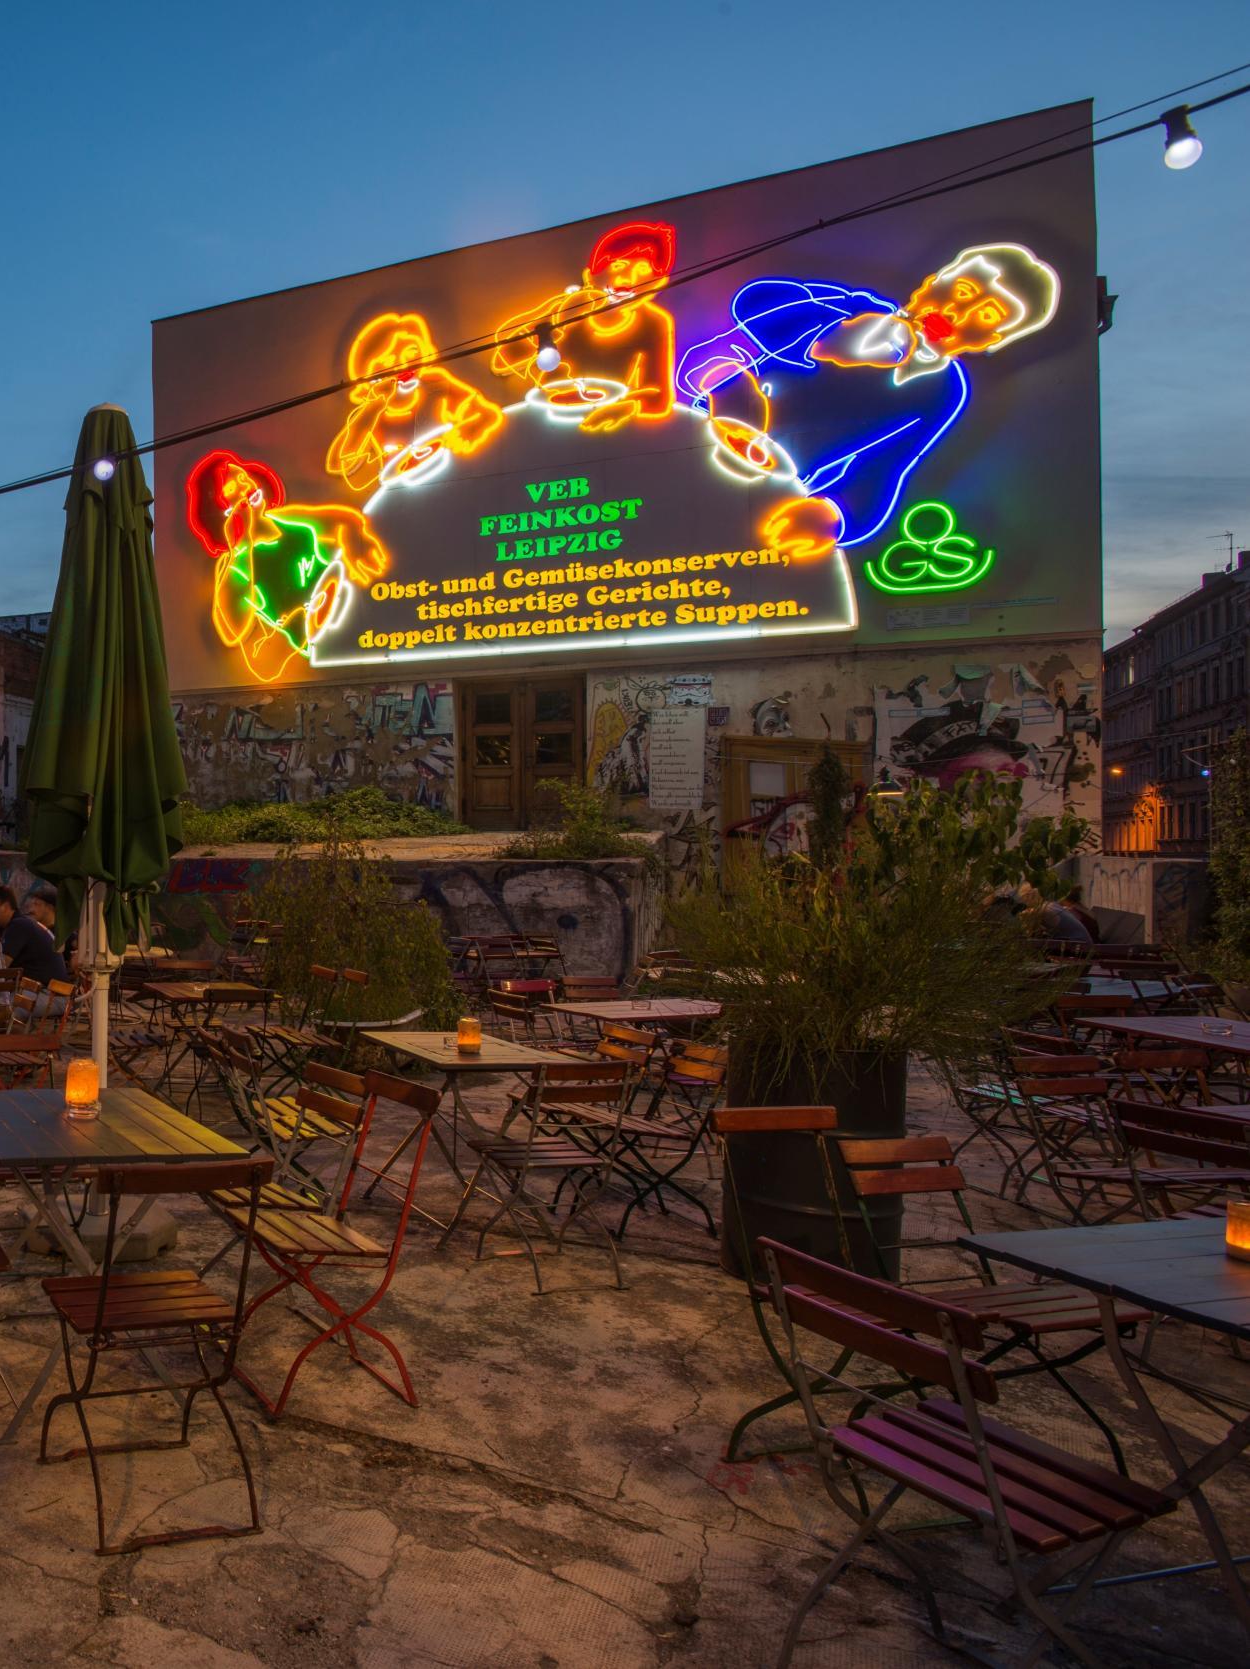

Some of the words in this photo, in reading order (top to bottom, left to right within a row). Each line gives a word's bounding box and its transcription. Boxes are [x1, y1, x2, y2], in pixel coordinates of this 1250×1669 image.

[525, 477, 590, 504] VEB
[479, 497, 643, 537] FEINKOST
[495, 528, 623, 562] LEIPZIG
[502, 547, 789, 590] Gemüsekonserven,
[416, 590, 579, 622] tischfertige
[586, 578, 732, 608] Gerichte,
[358, 622, 458, 650] doppelt
[462, 609, 668, 642] konzentrierte
[674, 598, 810, 626] Suppen.
